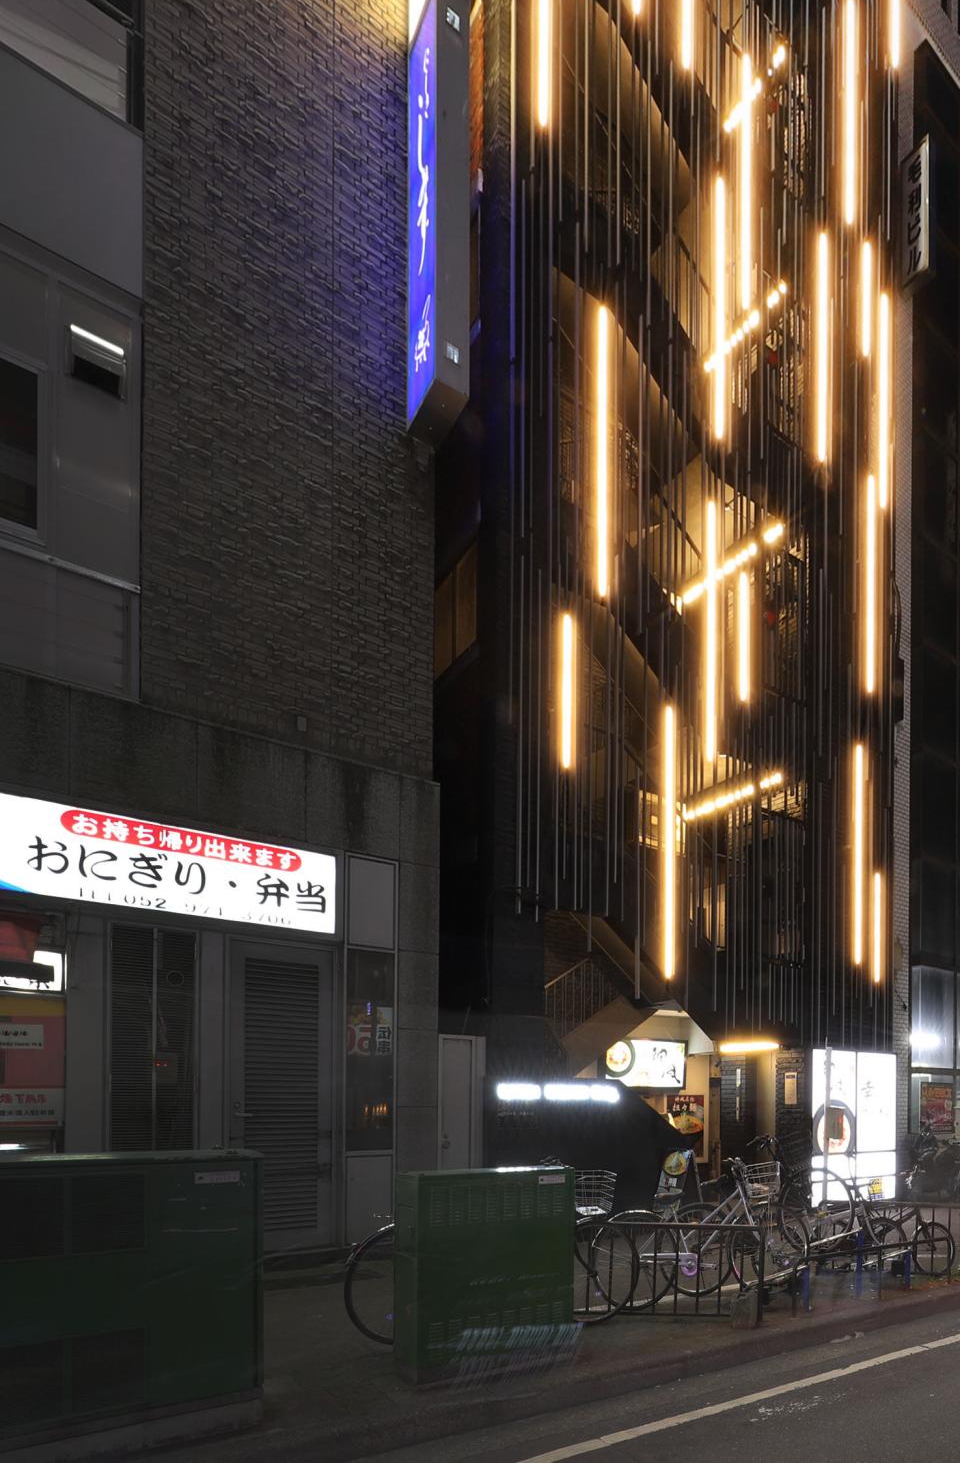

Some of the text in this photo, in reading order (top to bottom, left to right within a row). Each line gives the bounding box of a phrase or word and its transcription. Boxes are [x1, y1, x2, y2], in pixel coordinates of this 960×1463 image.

[27, 835, 327, 914] おにぎり・弁当
[71, 813, 297, 871] お持ち帰り出来ます
